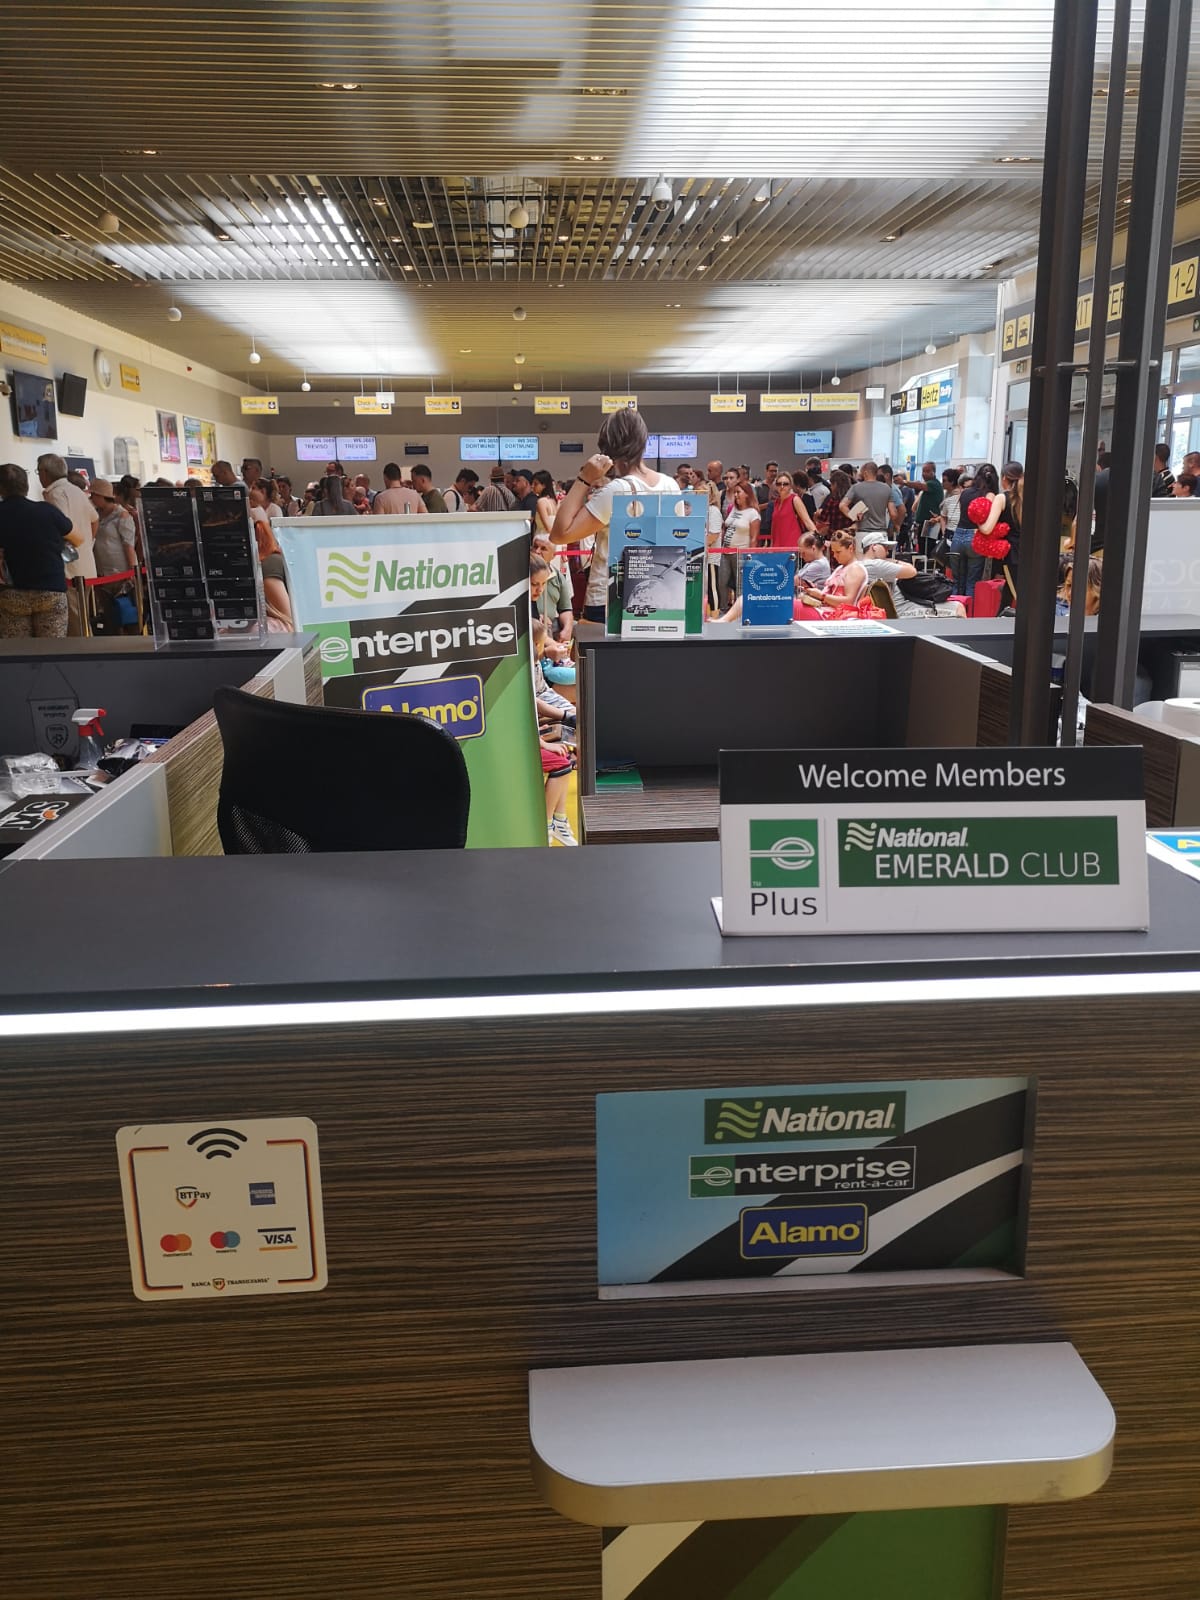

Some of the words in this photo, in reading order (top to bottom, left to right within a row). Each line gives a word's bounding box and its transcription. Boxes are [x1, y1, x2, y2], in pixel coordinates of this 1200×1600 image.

[1174, 263, 1195, 298] 1-2
[922, 388, 938, 404] Hertz
[373, 554, 495, 593] National
[747, 593, 792, 601] Rentalcars.com
[320, 619, 515, 663] enterprise
[798, 763, 928, 789] Welcome
[936, 761, 1067, 788] Members
[876, 826, 968, 849] National
[875, 852, 1010, 880] EMERALD
[1020, 851, 1101, 879] CLUB
[751, 890, 818, 916] Plus
[761, 1102, 896, 1134] National
[703, 1156, 912, 1188] enterprise
[834, 1178, 910, 1190] rent-a-car
[263, 1233, 293, 1244] VISA
[748, 1221, 862, 1245] Alamo
